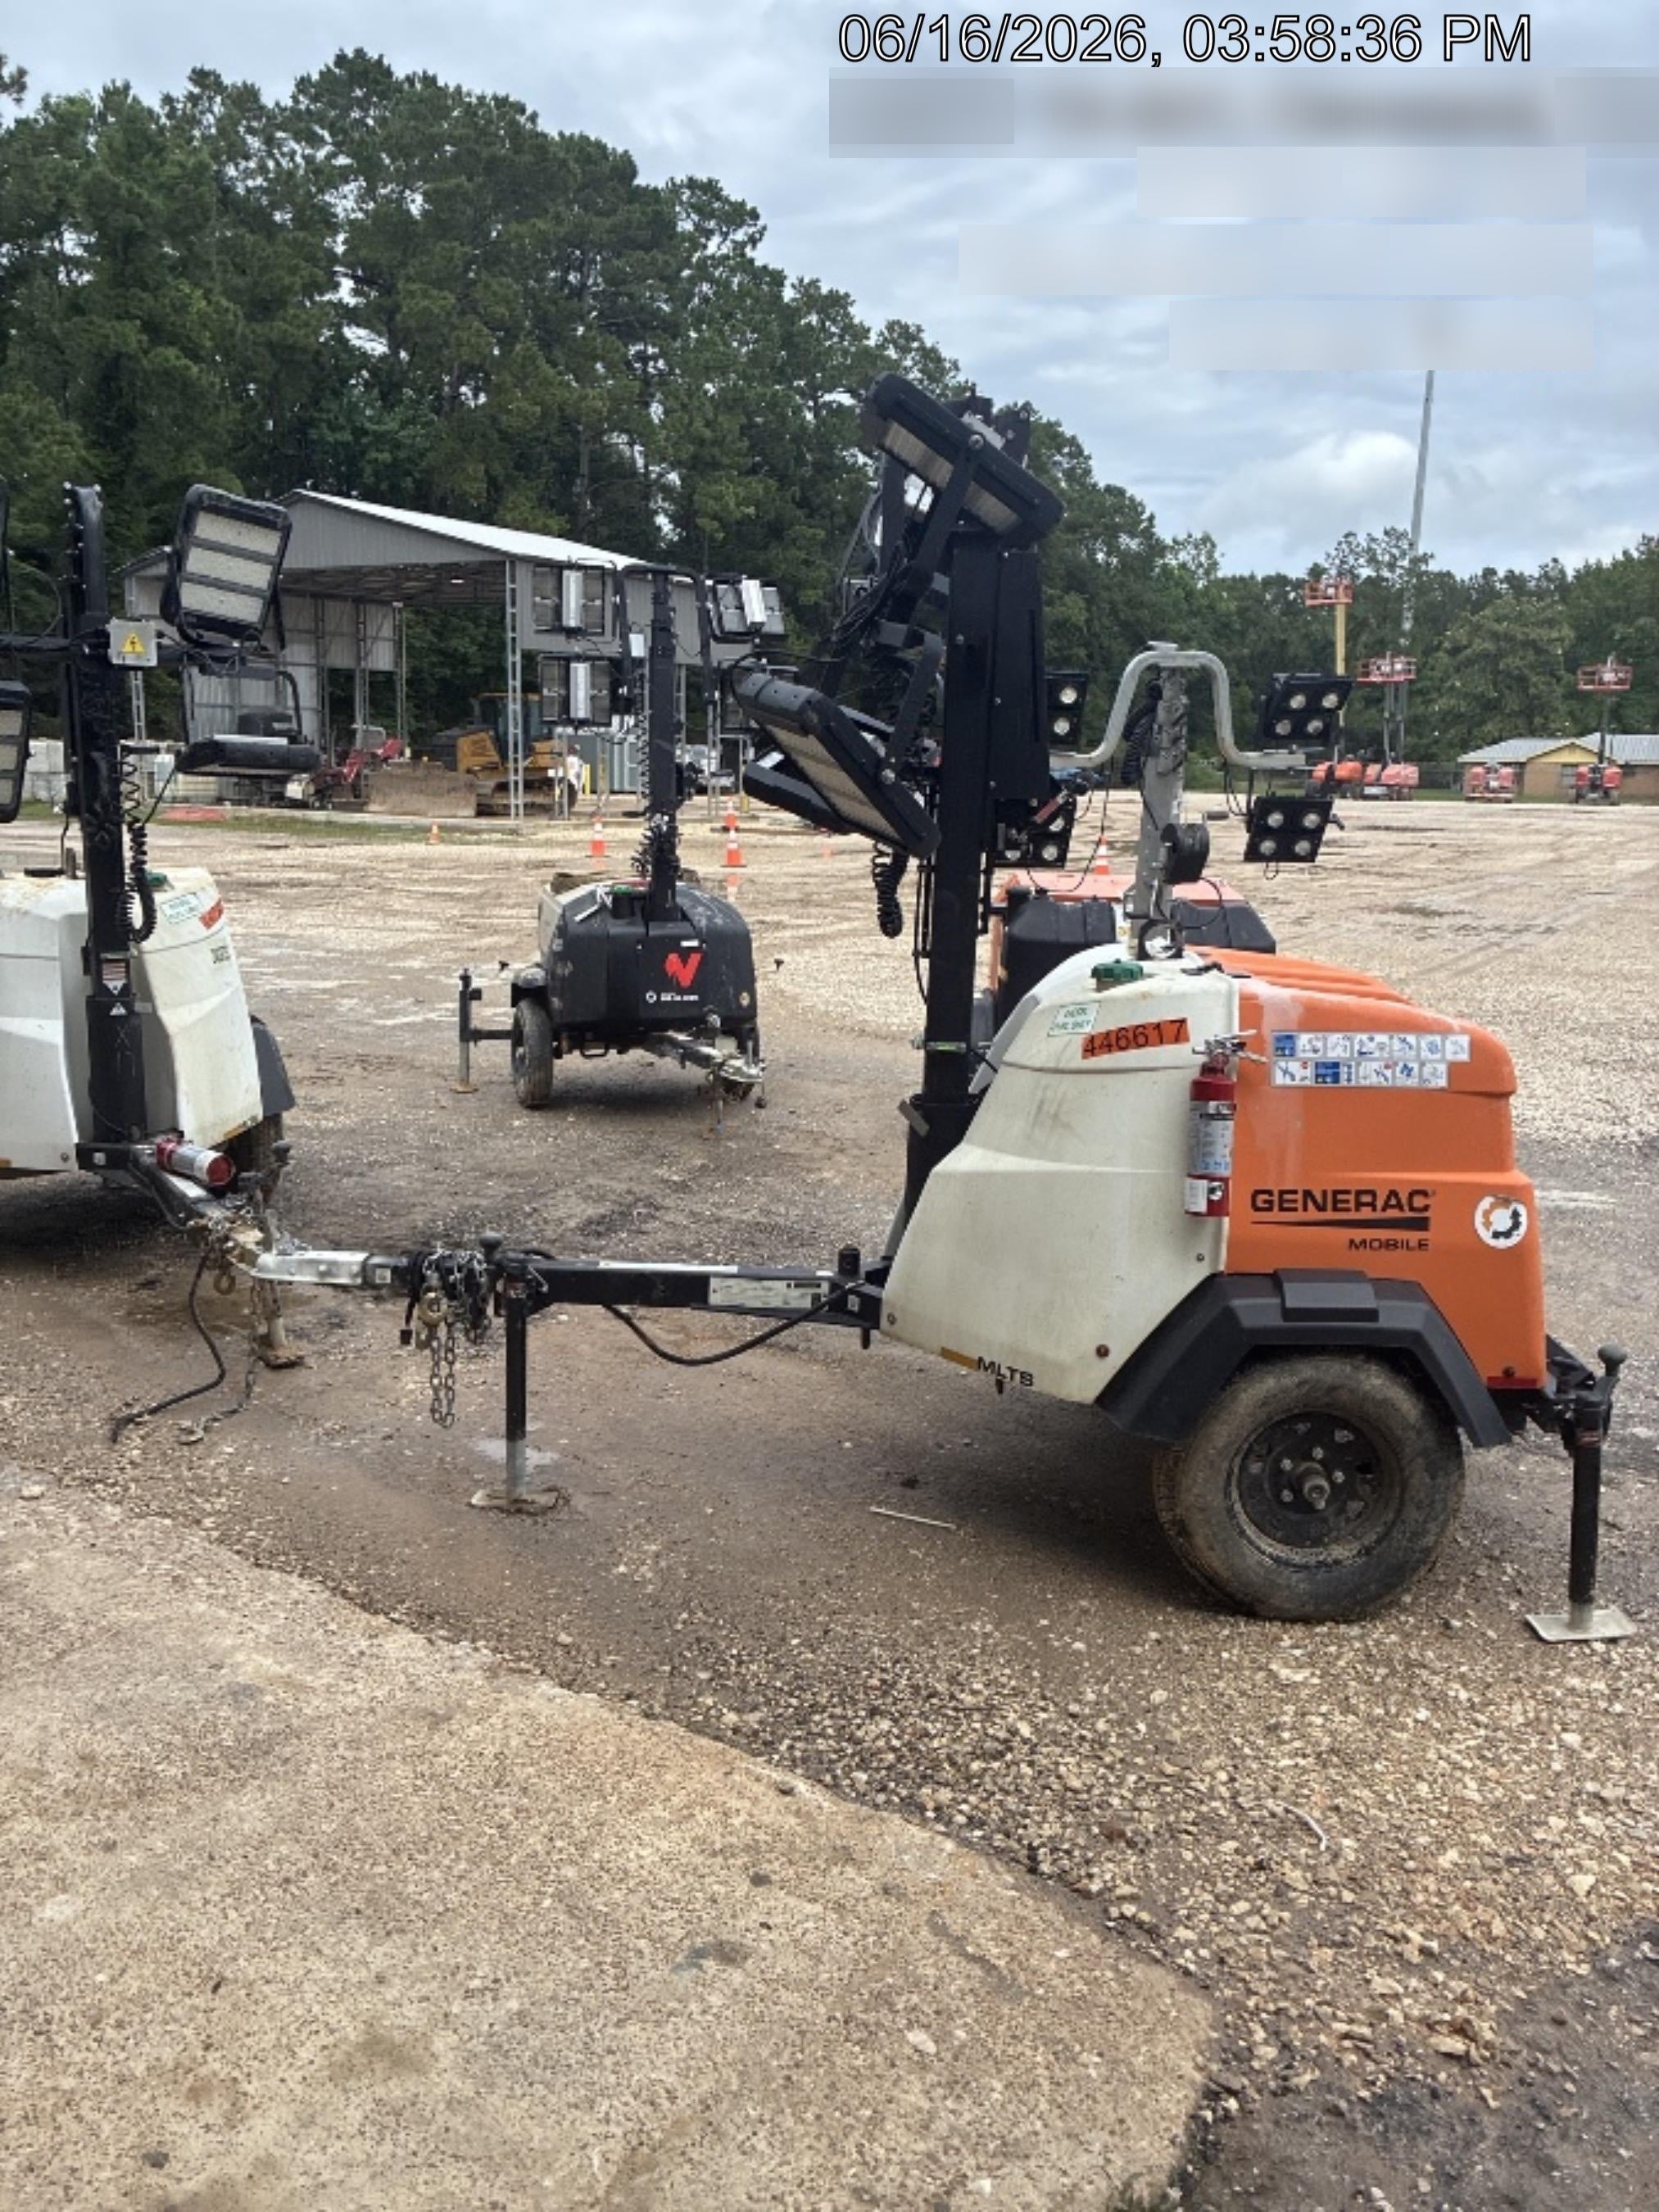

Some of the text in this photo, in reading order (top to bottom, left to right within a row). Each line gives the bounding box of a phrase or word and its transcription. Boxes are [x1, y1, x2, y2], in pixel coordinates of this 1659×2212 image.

[1083, 1018, 1188, 1058] 446617
[1250, 1189, 1432, 1213] GENERAC
[1349, 1238, 1430, 1252] MOBILE
